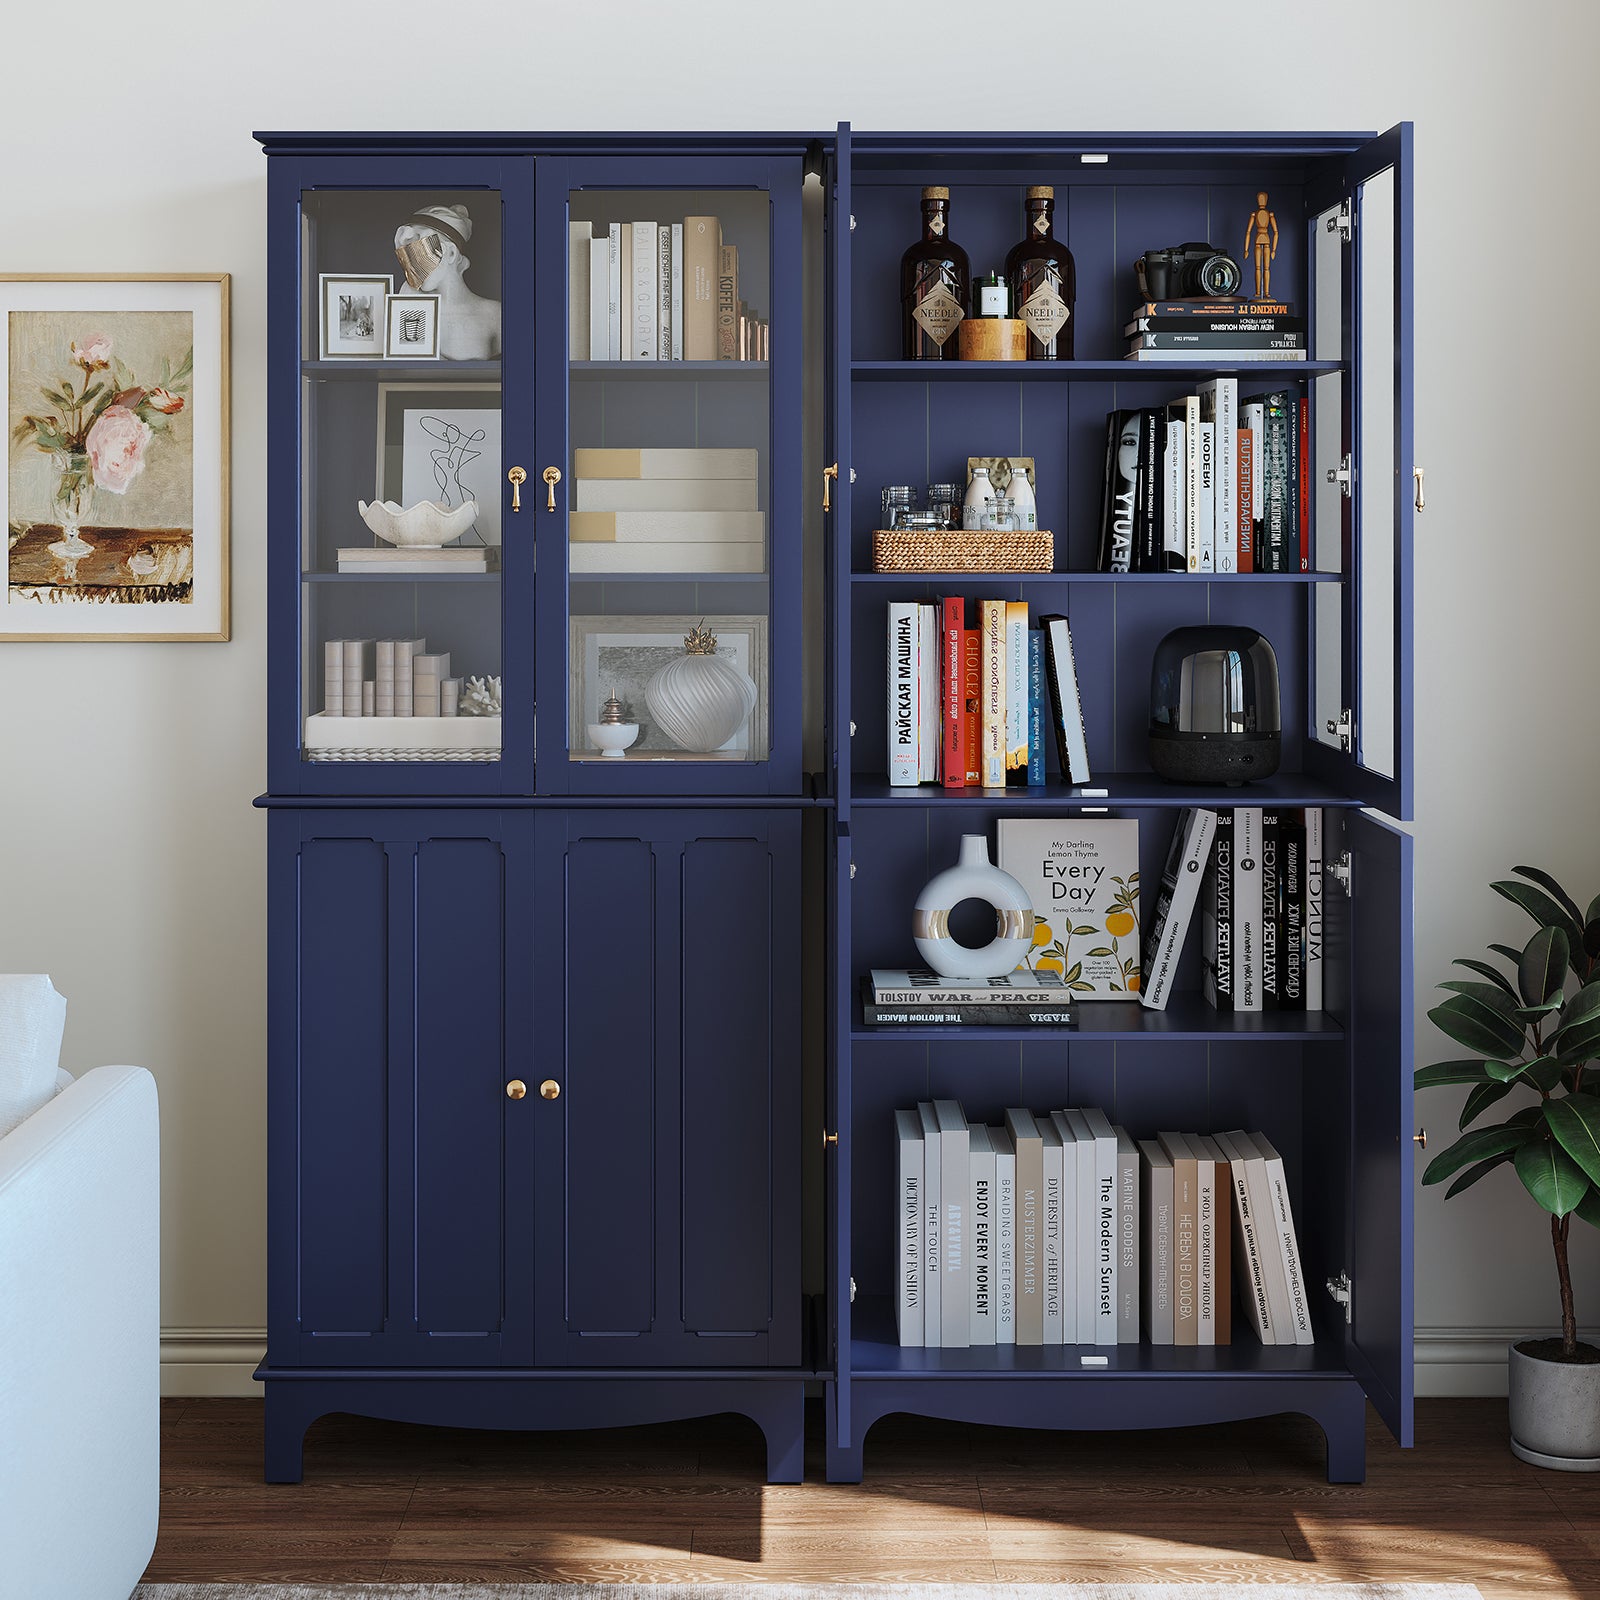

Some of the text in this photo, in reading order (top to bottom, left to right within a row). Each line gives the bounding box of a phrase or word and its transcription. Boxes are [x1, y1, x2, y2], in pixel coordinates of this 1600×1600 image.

[636, 227, 651, 345] BALLS & GLORY
[720, 276, 734, 312] KOFFIE
[1238, 305, 1249, 313] IT
[1250, 305, 1288, 314] MAKING
[920, 308, 958, 318] NEEDLE
[1026, 308, 1064, 318] NEEDLE
[898, 617, 911, 678] МАШИНА
[894, 684, 912, 744] РАЙСКАЯ
[1052, 841, 1094, 850] My Darling
[1074, 850, 1098, 858] Thyme
[1043, 860, 1105, 884] Every
[1052, 882, 1096, 905] Day
[877, 1014, 962, 1022] THE MOTION MAKER
[879, 993, 922, 1002] TOLSTOY
[928, 994, 972, 1002] WAR
[990, 994, 1050, 1002] PEACE
[928, 1205, 937, 1272] THE TOUCH
[1024, 1190, 1035, 1294] MUSTERZIMMER
[1124, 1169, 1133, 1267] MARINE GODDESS
[906, 1177, 918, 1308] DICTIONARY OF FASHION
[977, 1180, 988, 1315] ENJOY EVERY MOMENT
[1002, 1179, 1010, 1322] BRAIDING SWEETGRASS
[1048, 1178, 1057, 1316] DIVERSITY of HERITAGE
[1101, 1176, 1112, 1315] The Modern Sunset
